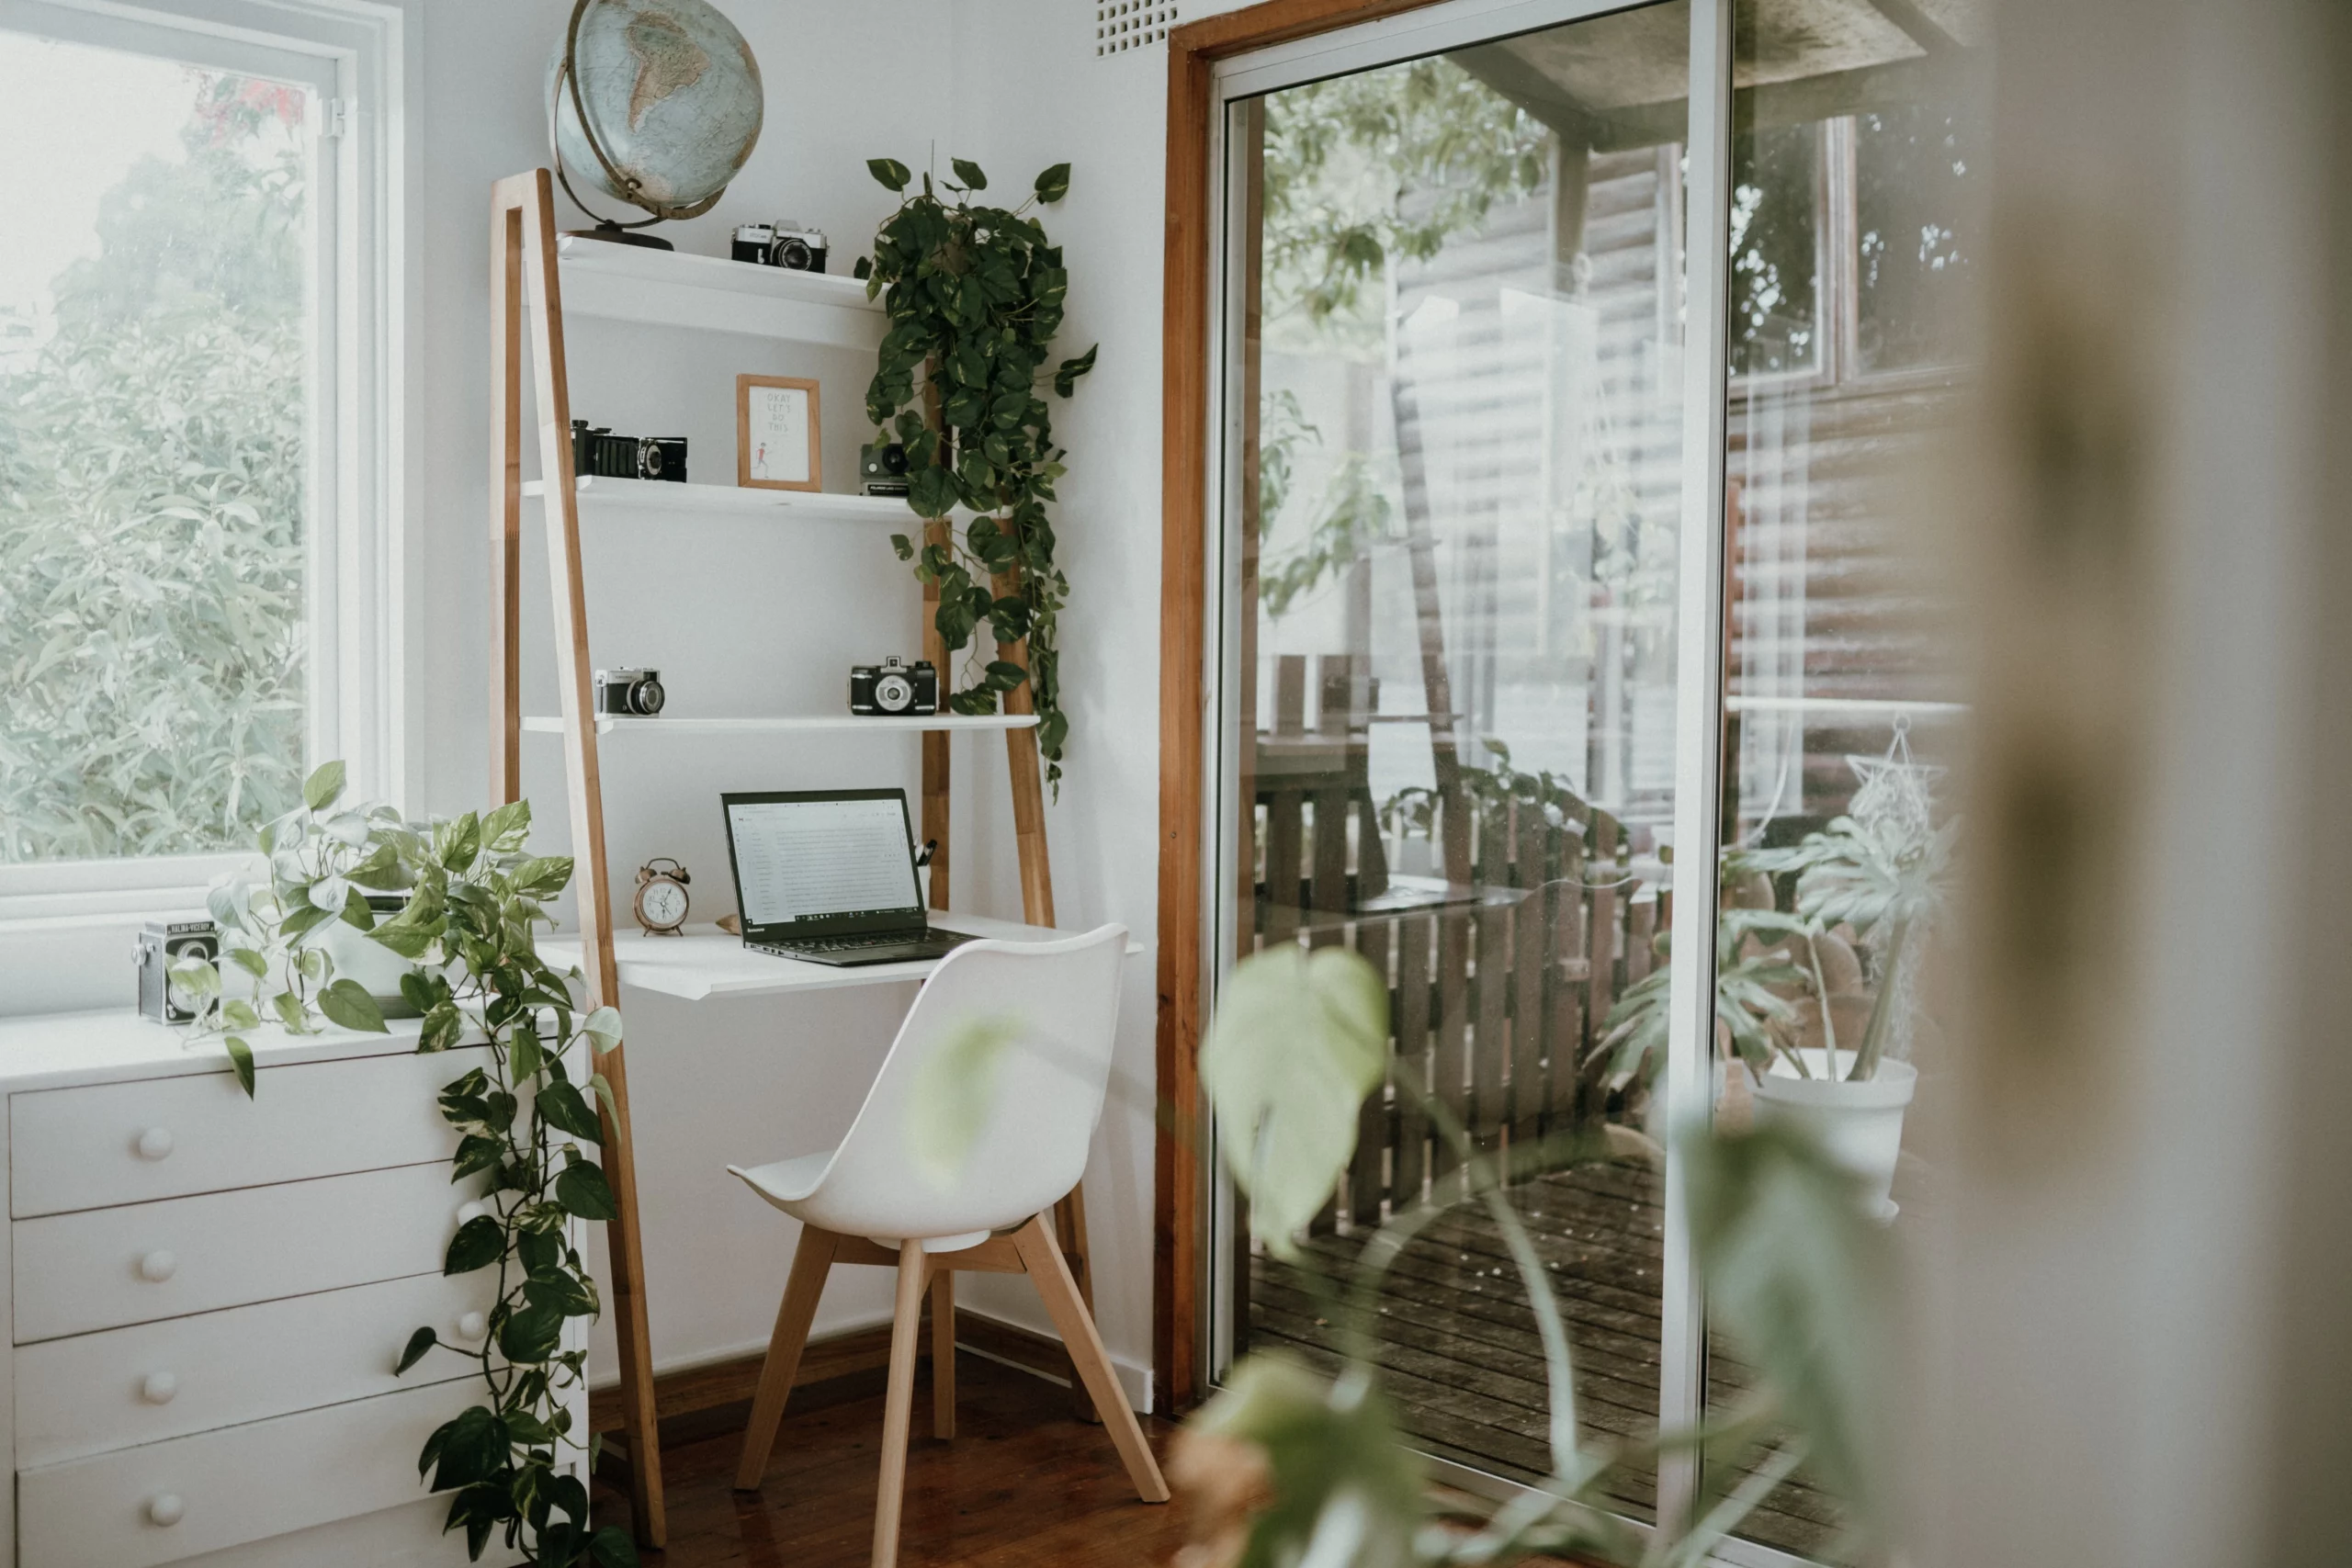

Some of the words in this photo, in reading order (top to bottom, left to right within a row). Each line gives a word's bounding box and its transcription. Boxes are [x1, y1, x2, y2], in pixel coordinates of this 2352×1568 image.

[767, 392, 790, 402] OKAY
[767, 403, 791, 413] LET'S
[772, 413, 785, 422] DO
[767, 422, 788, 433] THIS
[172, 922, 209, 933] HALINA-VICEROY
